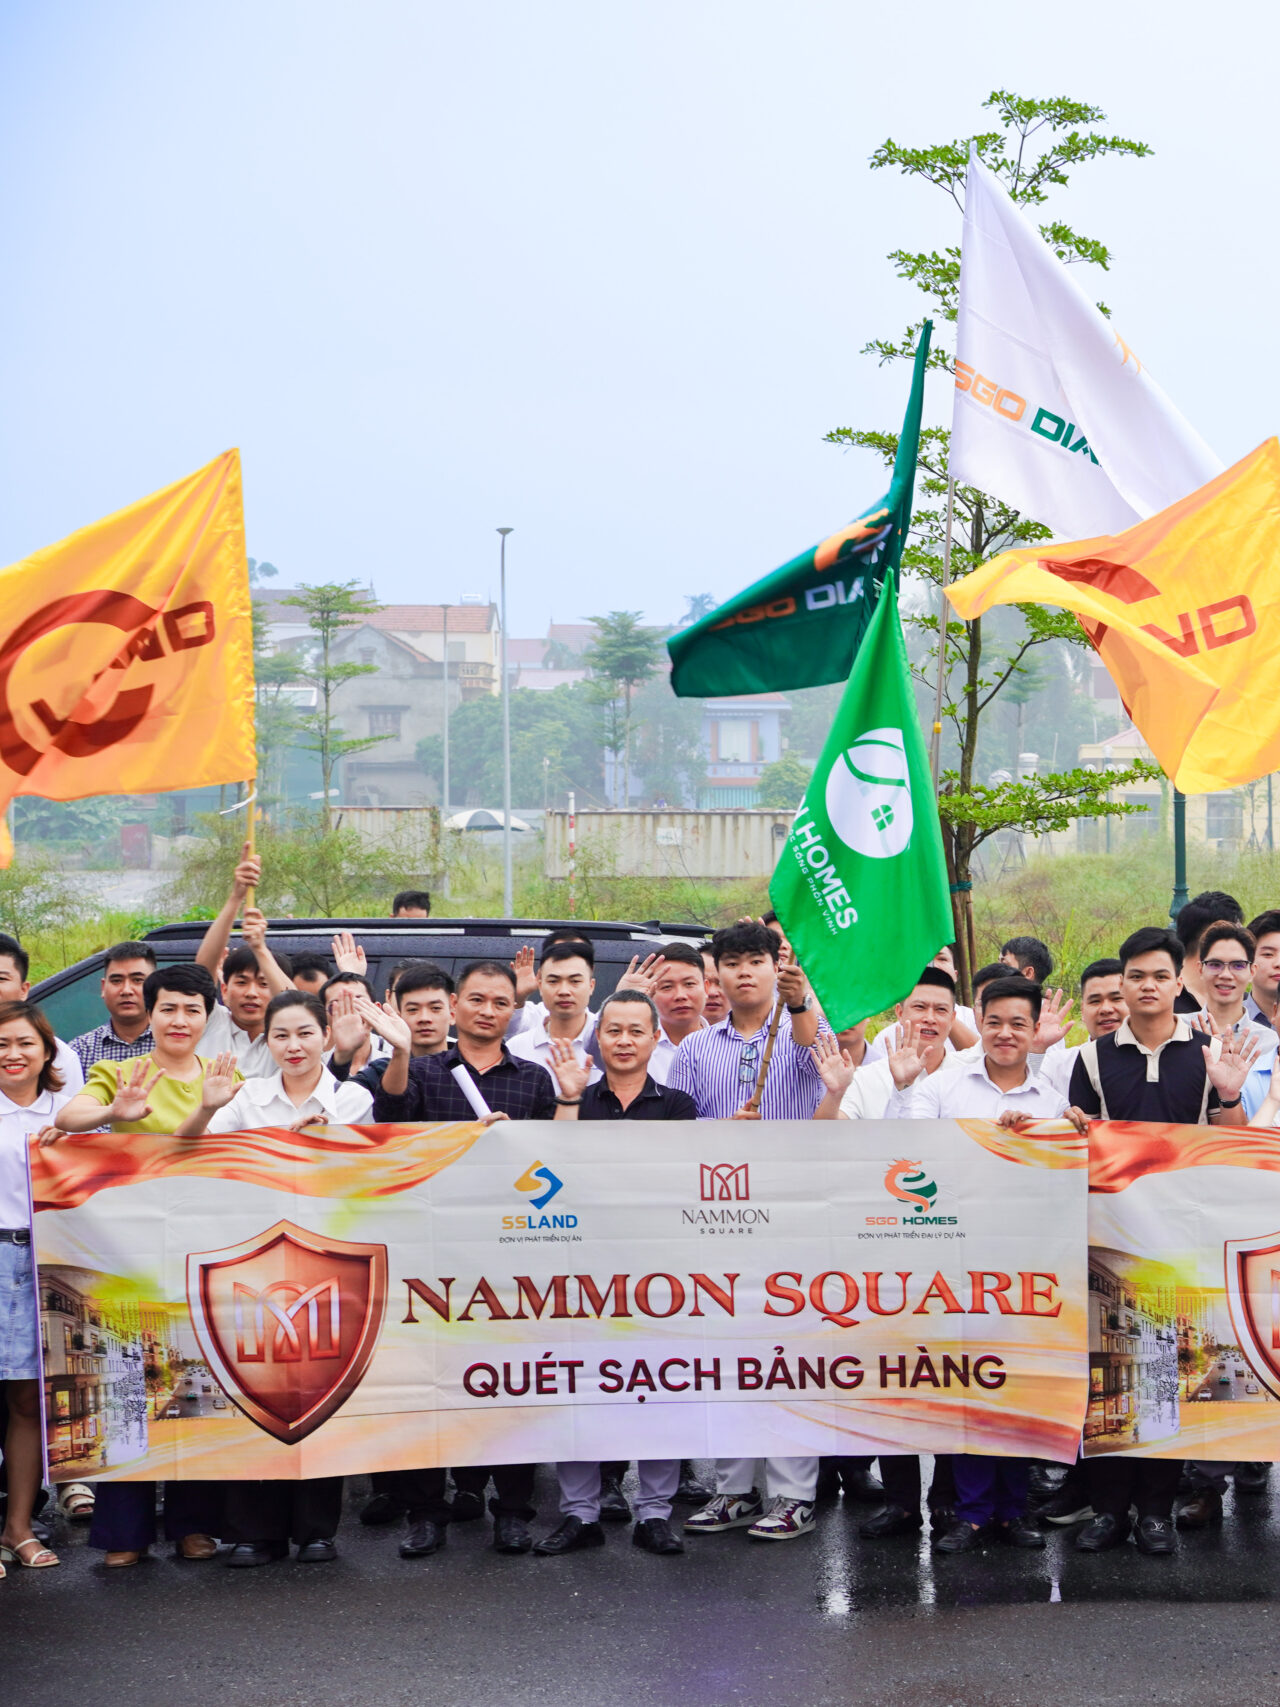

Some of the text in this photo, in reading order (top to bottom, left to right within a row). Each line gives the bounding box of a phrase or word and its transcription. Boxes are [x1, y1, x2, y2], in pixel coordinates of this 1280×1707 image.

[795, 820, 859, 930] HOMES
[822, 909, 839, 936] VINH
[502, 1214, 578, 1230] SSLAND
[682, 1208, 770, 1225] NAMMON
[865, 1216, 958, 1226] SGO HOMES
[401, 1270, 1063, 1328] NAMMON SQUARE
[462, 1344, 1007, 1403] QUÉT SẠCH BẢNG HÀNG
